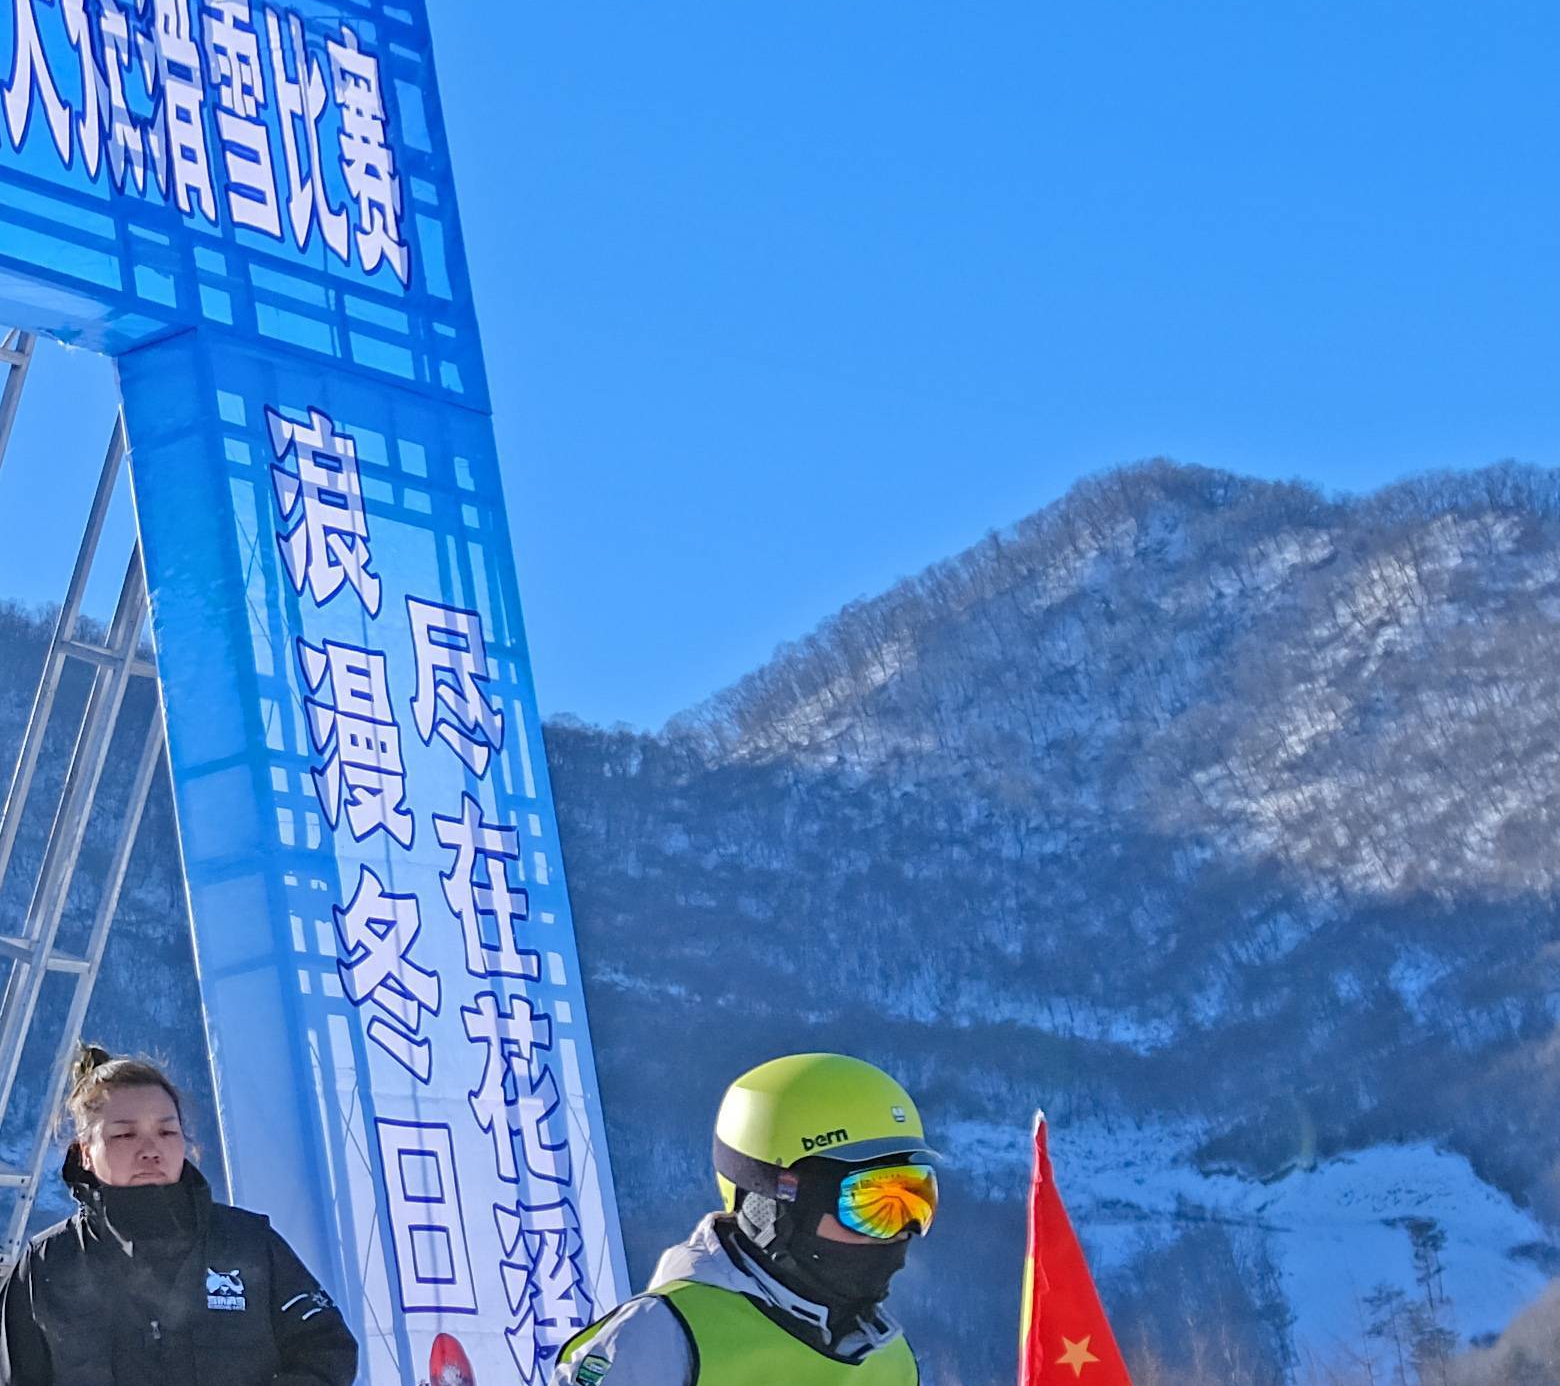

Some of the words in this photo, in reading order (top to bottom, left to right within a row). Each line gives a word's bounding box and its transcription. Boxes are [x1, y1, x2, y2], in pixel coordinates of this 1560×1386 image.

[264, 405, 477, 1314] 浪漫冬日
[801, 1128, 849, 1151] bern
